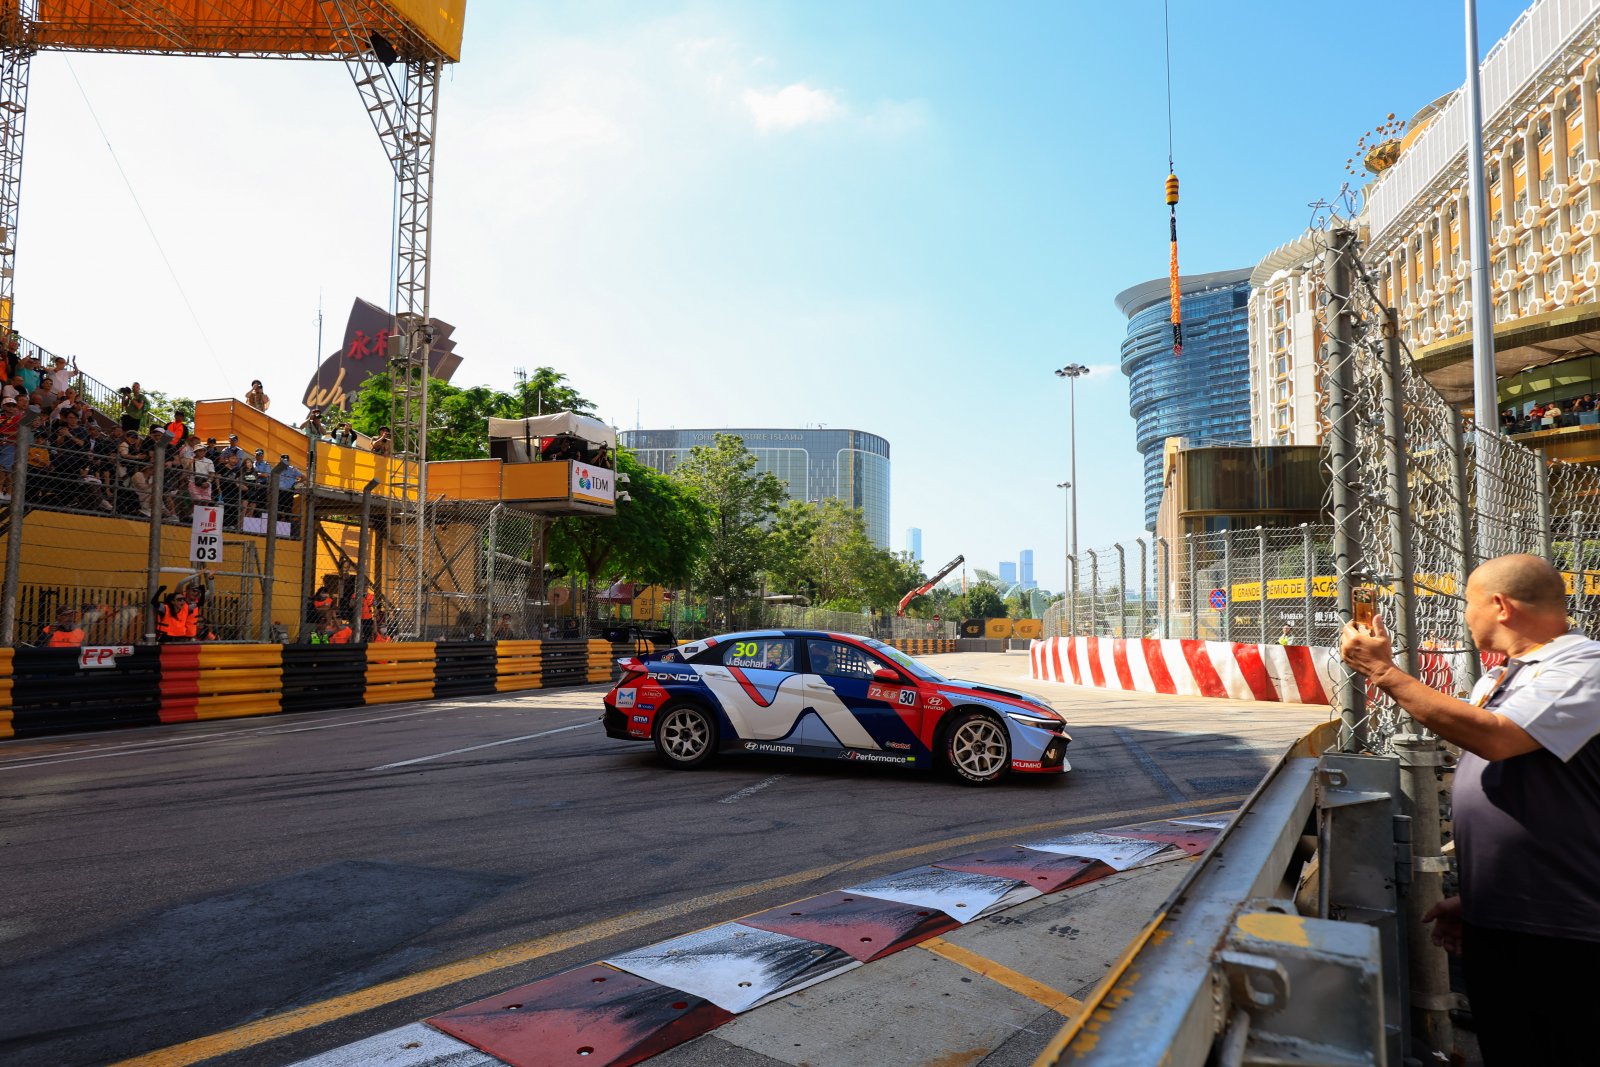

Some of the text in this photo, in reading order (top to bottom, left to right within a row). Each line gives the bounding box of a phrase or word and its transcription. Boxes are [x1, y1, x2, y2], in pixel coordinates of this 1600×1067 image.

[770, 432, 803, 441] ISLAND
[592, 476, 609, 492] TDM
[197, 535, 218, 546] MP
[196, 547, 217, 560] 03
[1237, 587, 1260, 598] GRANDE
[1290, 583, 1302, 594] DE
[733, 642, 758, 657] 30
[82, 647, 130, 665] FP 3E
[647, 672, 700, 682] RONDO
[870, 687, 882, 697] 72
[900, 690, 915, 705] 30
[923, 704, 946, 712] HYUNDAI
[633, 715, 648, 724] STM
[759, 744, 794, 753] HYUNDAI
[891, 741, 912, 750] Castrol
[855, 753, 906, 763] Performance
[1012, 761, 1042, 769] KUMHO
